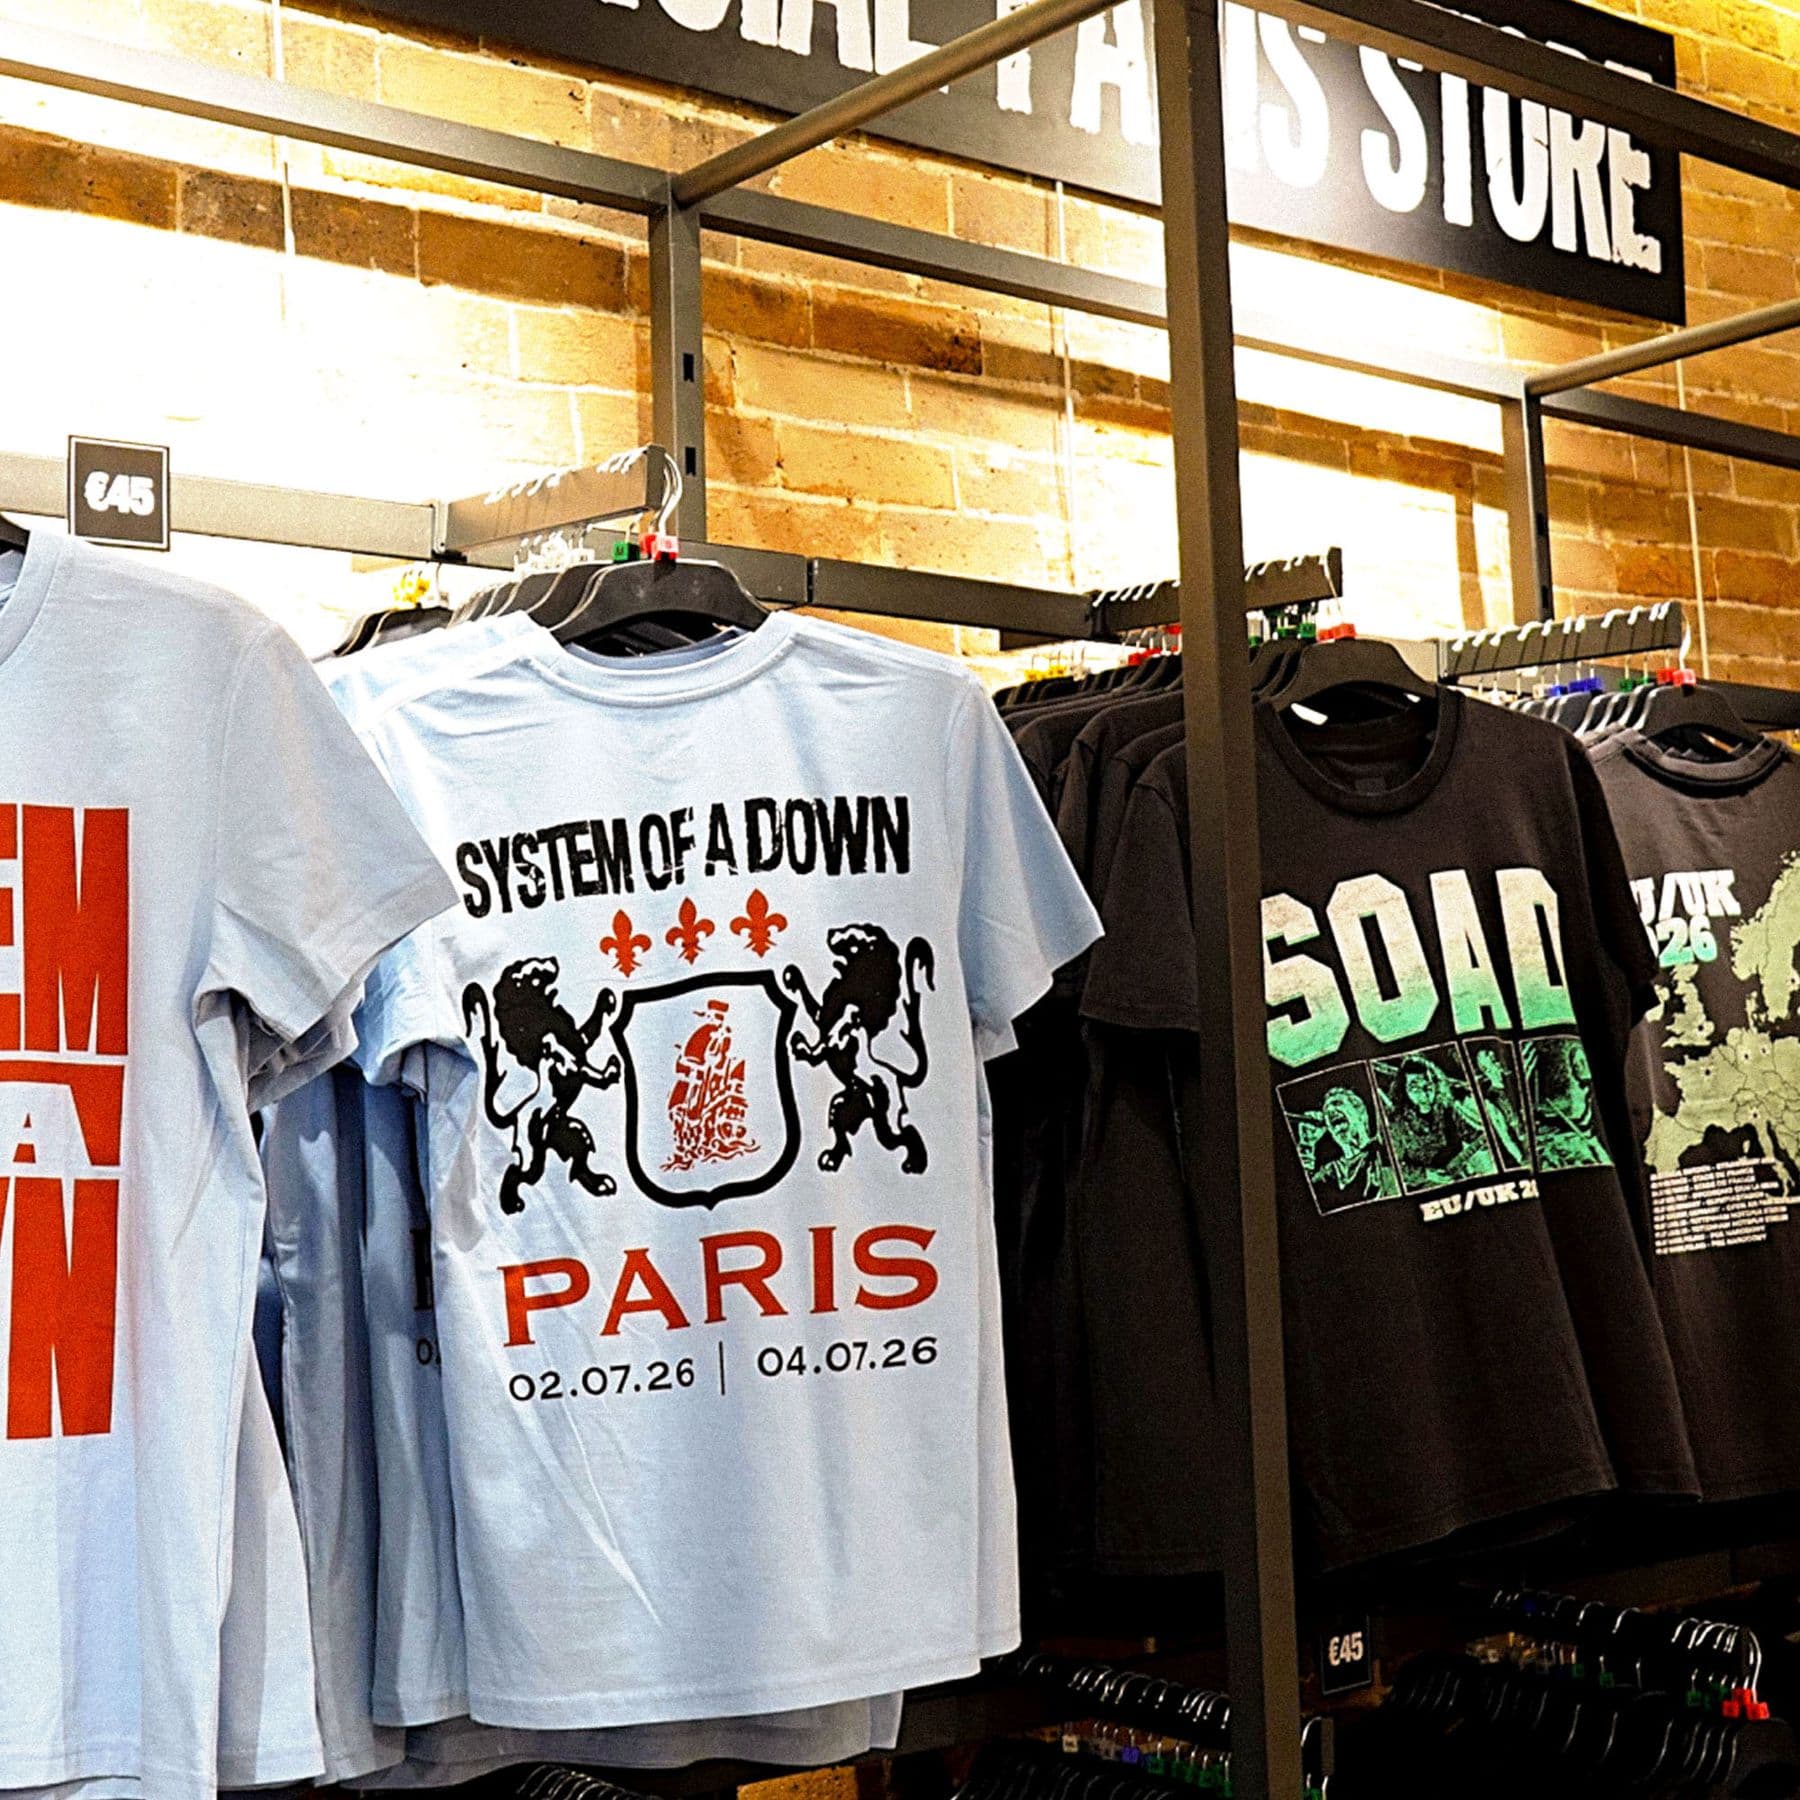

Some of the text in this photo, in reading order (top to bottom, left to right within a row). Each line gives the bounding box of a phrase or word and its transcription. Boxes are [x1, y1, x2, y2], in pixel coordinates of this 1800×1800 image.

[1358, 0, 1663, 274] STORE
[83, 470, 155, 517] €45
[456, 795, 911, 920] SYSTEM OF A DOWN
[1260, 867, 1578, 1068] SOAD
[1419, 1182, 1520, 1222] EU/UK
[497, 1224, 939, 1347] PARIS
[509, 1336, 938, 1402] 02.07.26 04.07.26
[1328, 1631, 1364, 1667] €45
